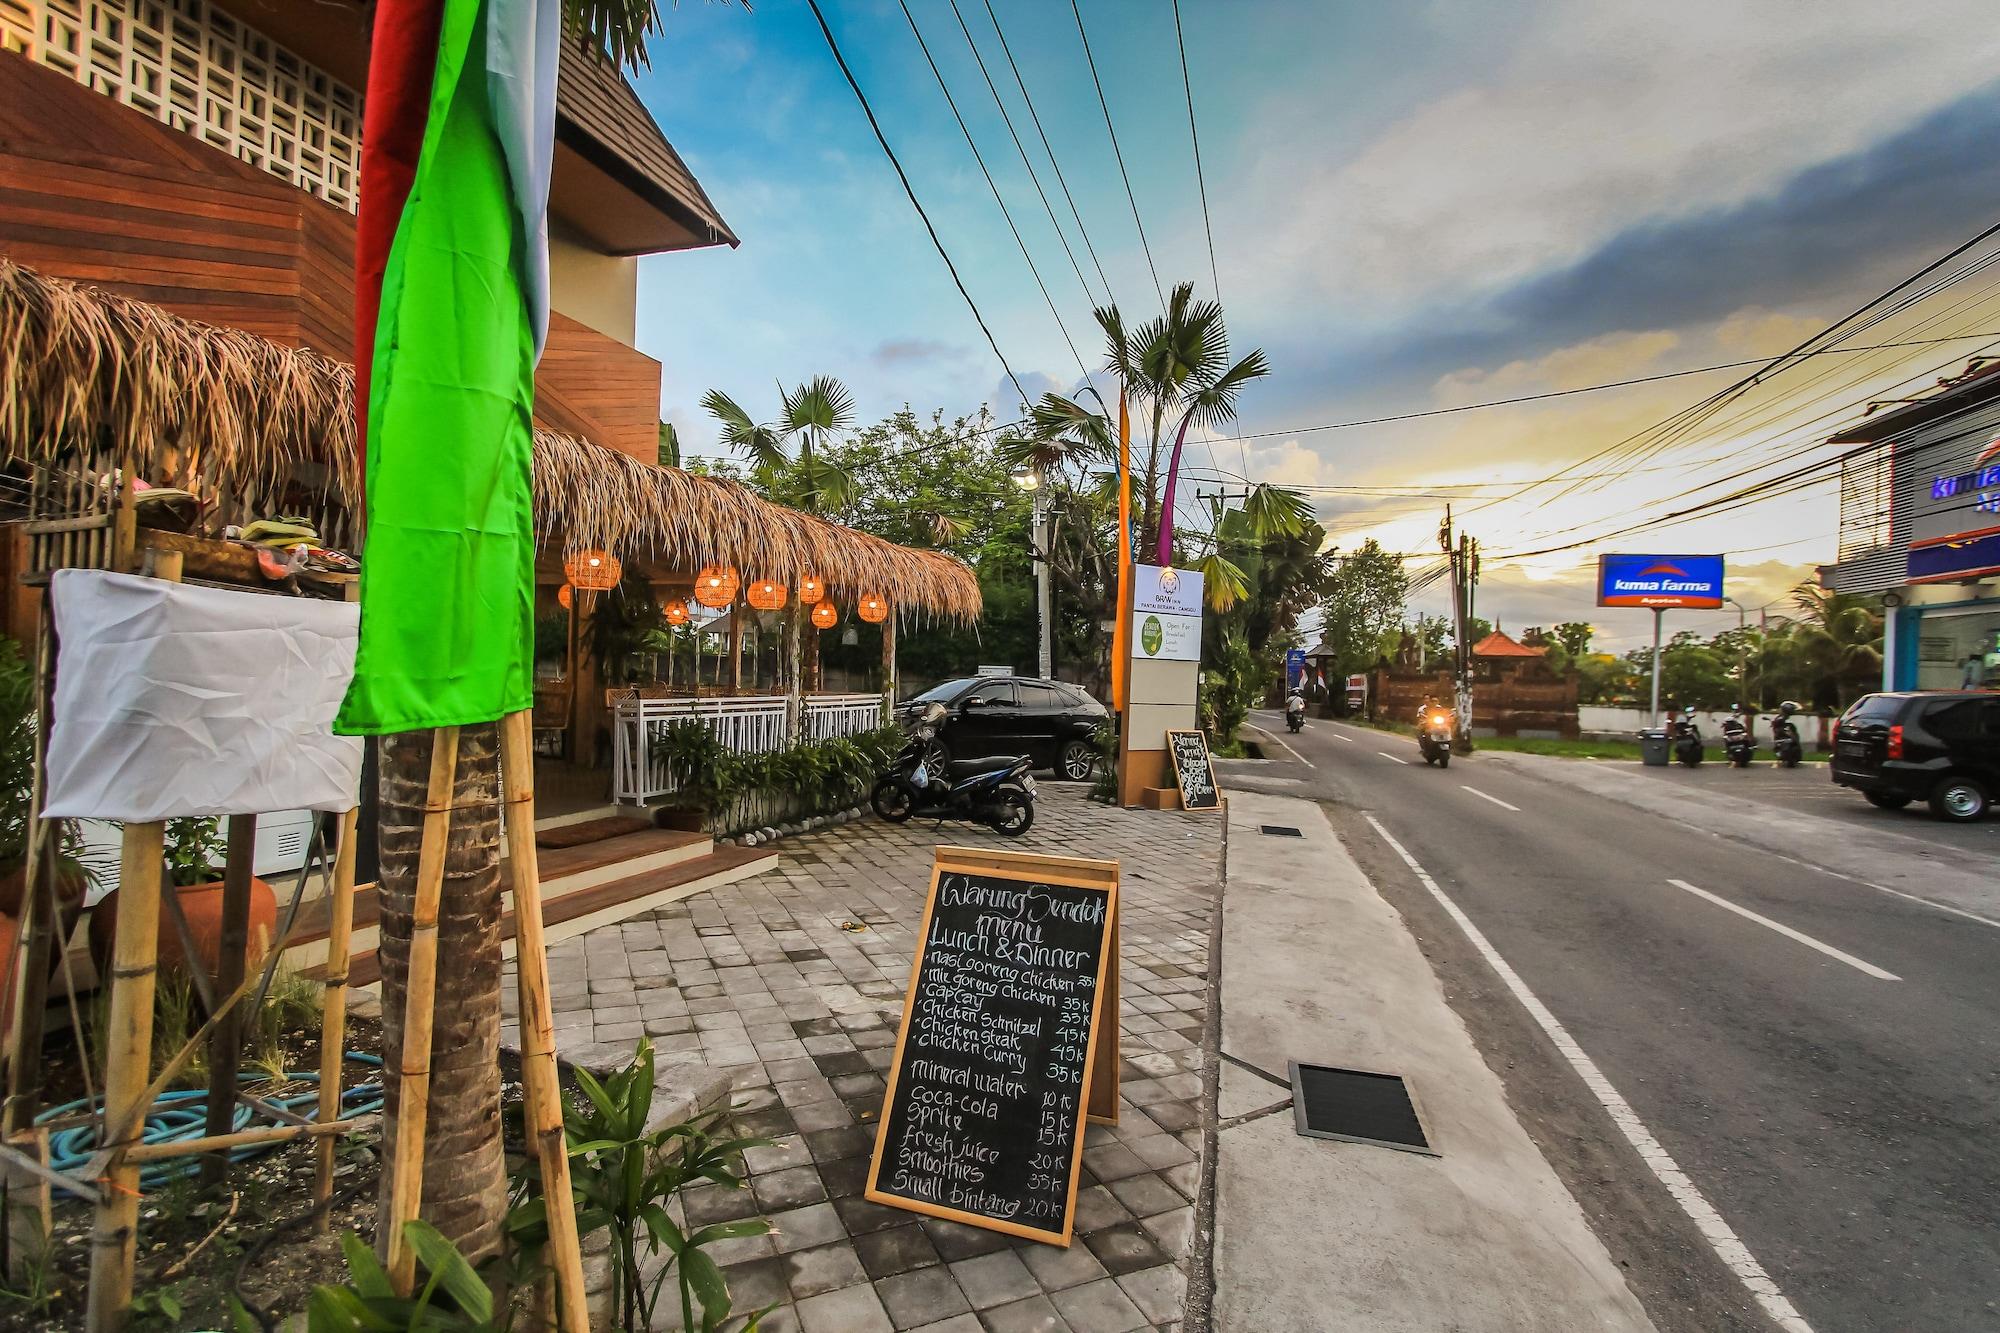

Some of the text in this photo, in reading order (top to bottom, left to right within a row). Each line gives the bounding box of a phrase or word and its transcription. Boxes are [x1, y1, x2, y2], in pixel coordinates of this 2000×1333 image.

[1661, 579, 1711, 592] farma
[941, 877, 1105, 925] Warung Sendok
[929, 917, 1090, 969] Lunch & Dinner
[957, 959, 1019, 983] goreng
[950, 974, 998, 997] goreng
[981, 1013, 1042, 1037] Schnitzel
[981, 1029, 1022, 1051] Steak
[907, 1102, 962, 1131] Sprite
[950, 1136, 1000, 1164] juice
[899, 1147, 984, 1182] Smoothies
[891, 1169, 943, 1200] Small
